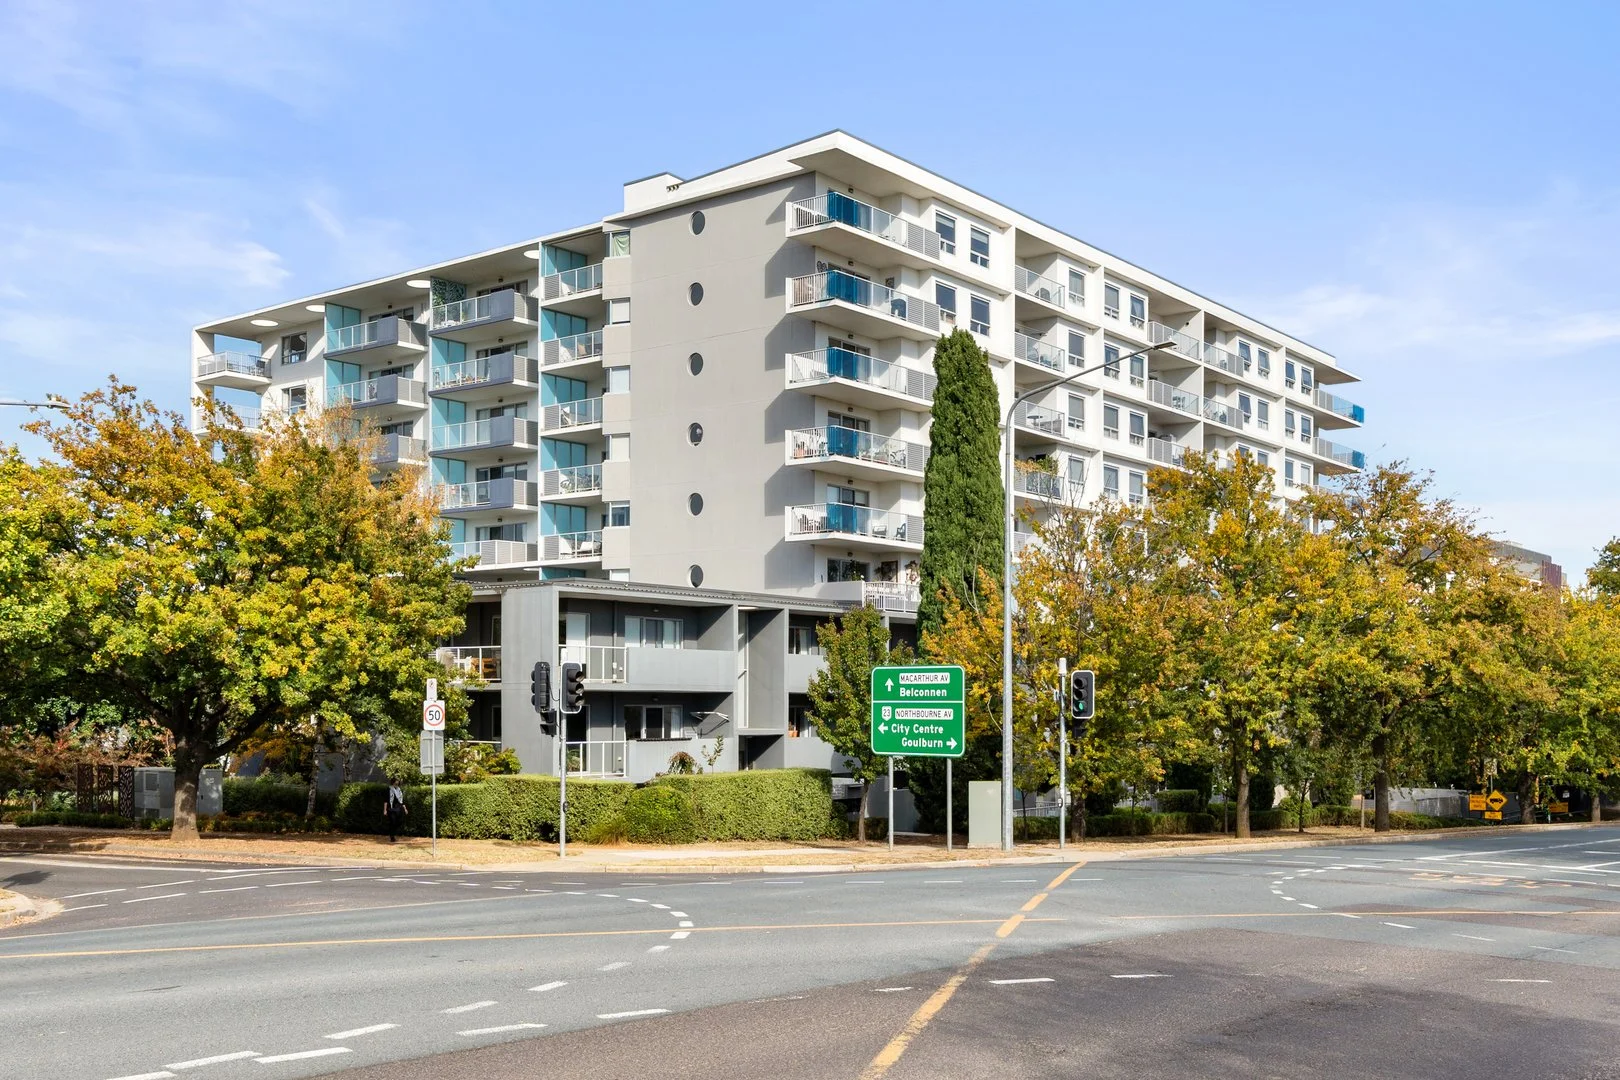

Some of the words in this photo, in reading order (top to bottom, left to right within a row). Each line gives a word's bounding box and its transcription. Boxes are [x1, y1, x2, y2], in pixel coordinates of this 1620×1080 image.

[900, 687, 947, 697] Belconnen
[428, 710, 441, 721] 50
[883, 709, 891, 718] 23
[896, 710, 941, 718] NORTHBOURNE
[891, 723, 910, 735] City
[913, 723, 944, 734] Centre
[901, 737, 943, 747] Goulburn
